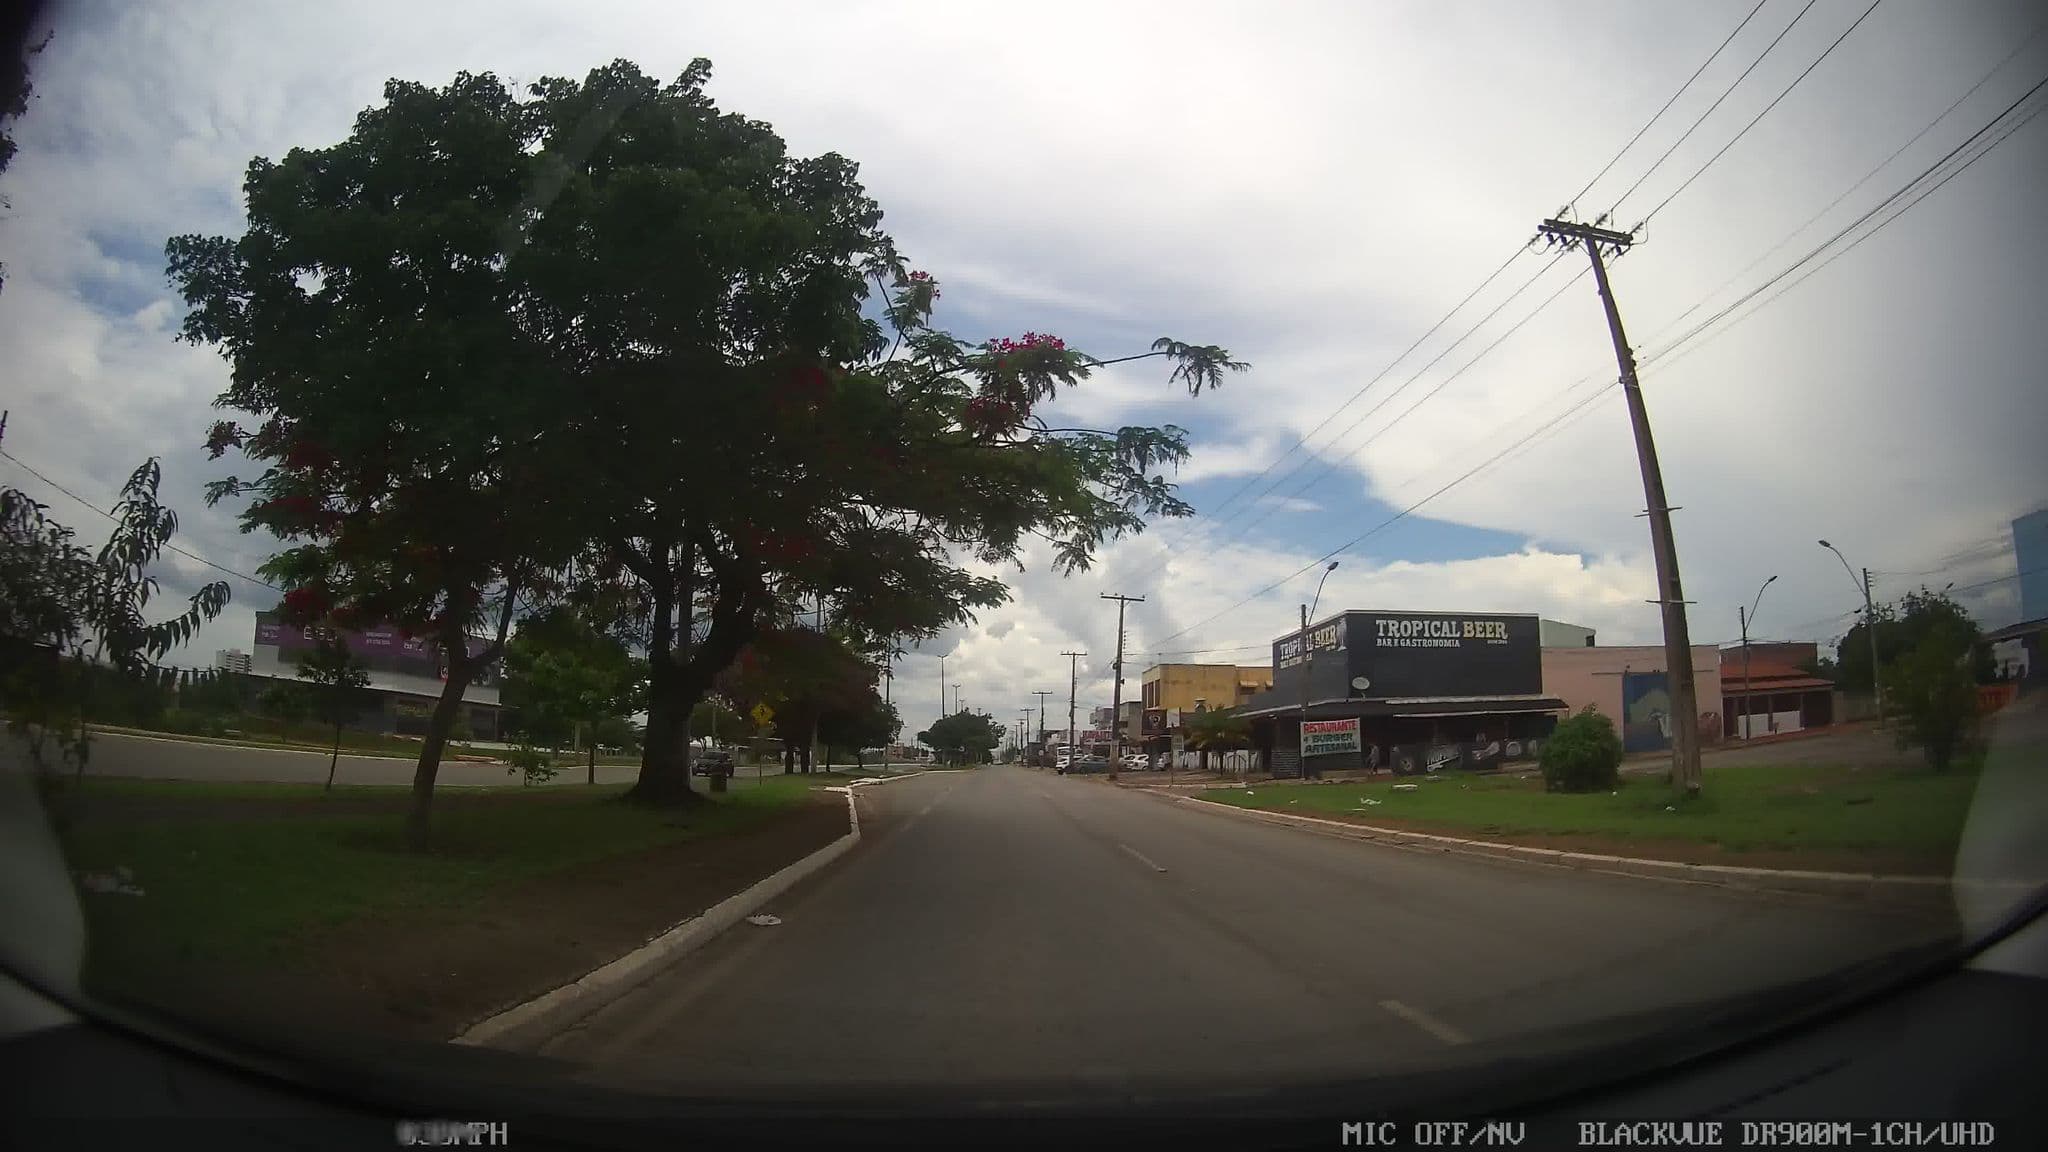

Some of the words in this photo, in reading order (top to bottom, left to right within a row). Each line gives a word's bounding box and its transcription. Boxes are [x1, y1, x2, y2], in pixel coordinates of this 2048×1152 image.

[1375, 619, 1461, 638] TROPICAL
[1463, 621, 1508, 640] BEER
[1280, 633, 1314, 660] TROPIAL
[1376, 638, 1393, 647] BAR
[1399, 638, 1461, 648] GASTRONOMIA
[1303, 720, 1357, 734] RESTAURANTE
[1312, 732, 1353, 743] BURGER
[1304, 741, 1357, 753] ARTESANAL
